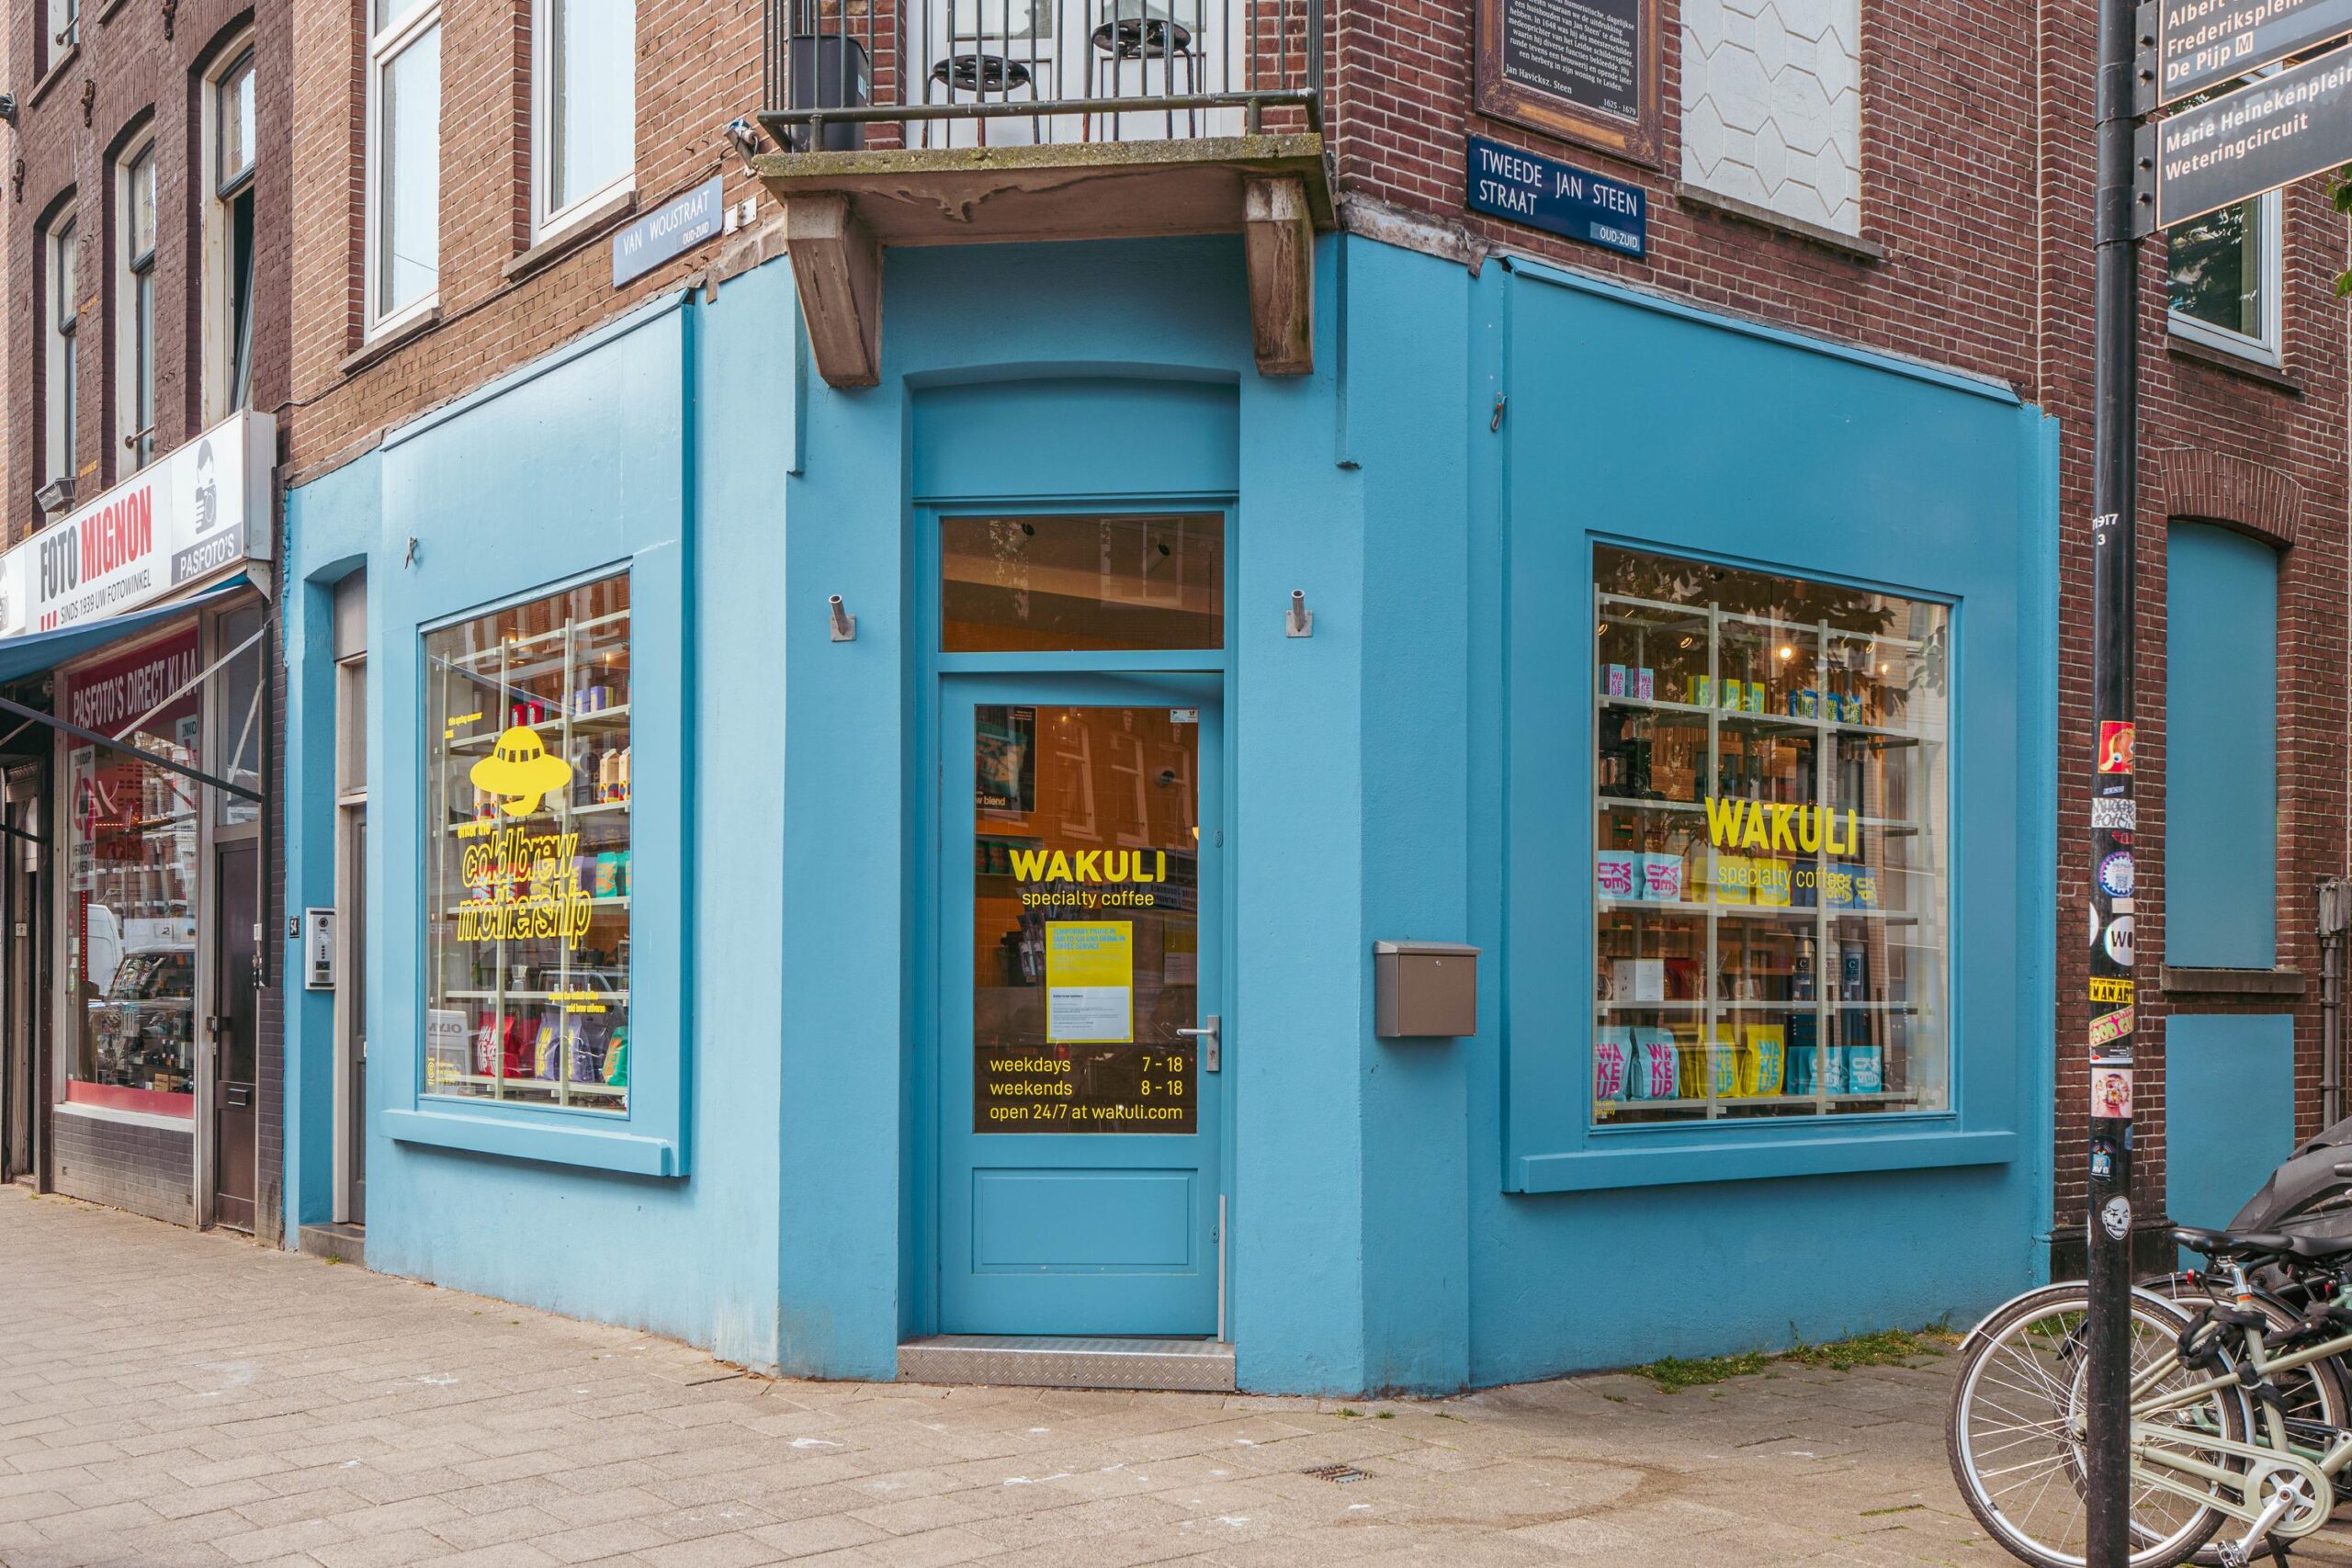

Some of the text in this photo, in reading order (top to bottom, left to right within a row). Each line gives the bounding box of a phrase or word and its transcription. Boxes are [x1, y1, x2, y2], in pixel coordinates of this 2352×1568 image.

[1527, 3, 1560, 22] huishouden
[1562, 17, 1572, 27] van
[1573, 20, 1583, 30] Jan
[1602, 31, 1608, 39] te
[1609, 34, 1630, 47] danken
[1547, 3, 1623, 37] waaraan we de uitdrukking
[2168, 0, 2225, 30] Albert
[1508, 17, 1551, 37] medeoprichter
[1552, 33, 1562, 42] van
[1564, 35, 1573, 46] het
[1574, 39, 1592, 52] Leidse
[1510, 6, 1532, 22] hebben.
[1534, 16, 1541, 25] In
[1543, 18, 1556, 30] 1648
[1557, 26, 1568, 35] was
[1569, 28, 1577, 39] hij
[1588, 38, 1632, 57] meesterschilder
[1510, 38, 1527, 49] runde
[1529, 43, 1548, 55] tevens
[1548, 51, 1559, 60] een
[1560, 53, 1588, 72] brouwerij
[1597, 68, 1618, 80] opende
[1619, 73, 1632, 85] later
[1513, 28, 1532, 40] waarin
[1533, 34, 1542, 46] hij
[1543, 39, 1565, 51] diverse
[1566, 46, 1589, 61] functies
[1621, 66, 1629, 76] Hij
[2166, 62, 2190, 83] De
[2196, 44, 2232, 72] Pijp
[1505, 63, 1572, 95] Jan Havicksz. Steen
[1519, 51, 1623, 92] een herberg in zijn woning te Leiden.
[1603, 98, 1618, 109] 1625
[1623, 105, 1636, 115] 1679
[2165, 113, 2309, 181] Weteringcircuit
[2166, 120, 2215, 153] Marie
[1479, 147, 1637, 217] TWEEDE JAN STEEN
[1479, 179, 1538, 216] STRAAT
[623, 189, 710, 257] VAN WOUSTRAAT
[683, 221, 709, 245] OUD-ZUID
[1600, 227, 1638, 249] OUD-ZUID
[40, 484, 152, 604] FOTO MIGNON
[180, 533, 235, 581] PASFOTO'S
[61, 568, 152, 626] SINDS 1939 UW FOTOWINKEL
[1611, 671, 1623, 680] WA
[1611, 680, 1623, 688] KE
[1641, 675, 1651, 683] WA
[74, 675, 124, 730] PASFOTO'S
[127, 659, 165, 716] DIRECT
[1611, 688, 1623, 696] UP
[983, 795, 1006, 807] blend
[458, 819, 492, 839] enter the
[1704, 796, 1857, 855] WAKULI
[462, 828, 514, 887] cold
[513, 827, 579, 883] brew
[1009, 850, 1166, 883] WAKULI
[1718, 865, 1792, 891] specialty
[1796, 866, 1846, 889] coffee
[1022, 890, 1097, 908] specialty
[1101, 890, 1155, 907] coffee
[457, 878, 593, 951] mothership
[1597, 1043, 1624, 1061] WA
[1645, 1043, 1673, 1061] WA
[1758, 1040, 1781, 1056] WA
[989, 1056, 1071, 1075] weekdays
[1142, 1056, 1150, 1072] 7
[1167, 1056, 1183, 1072] 18
[1597, 1062, 1621, 1081] KE
[1651, 1060, 1673, 1079] KE
[1759, 1056, 1780, 1075] KE
[989, 1080, 1073, 1096] weekends
[1141, 1080, 1150, 1096] 8
[1167, 1080, 1183, 1096] 18
[1596, 1081, 1620, 1100] UP
[1651, 1079, 1673, 1097] UP
[1715, 1074, 1735, 1093] UP
[1758, 1075, 1779, 1092] UP
[989, 1103, 1183, 1122] open 24/7 at wakuli.com
